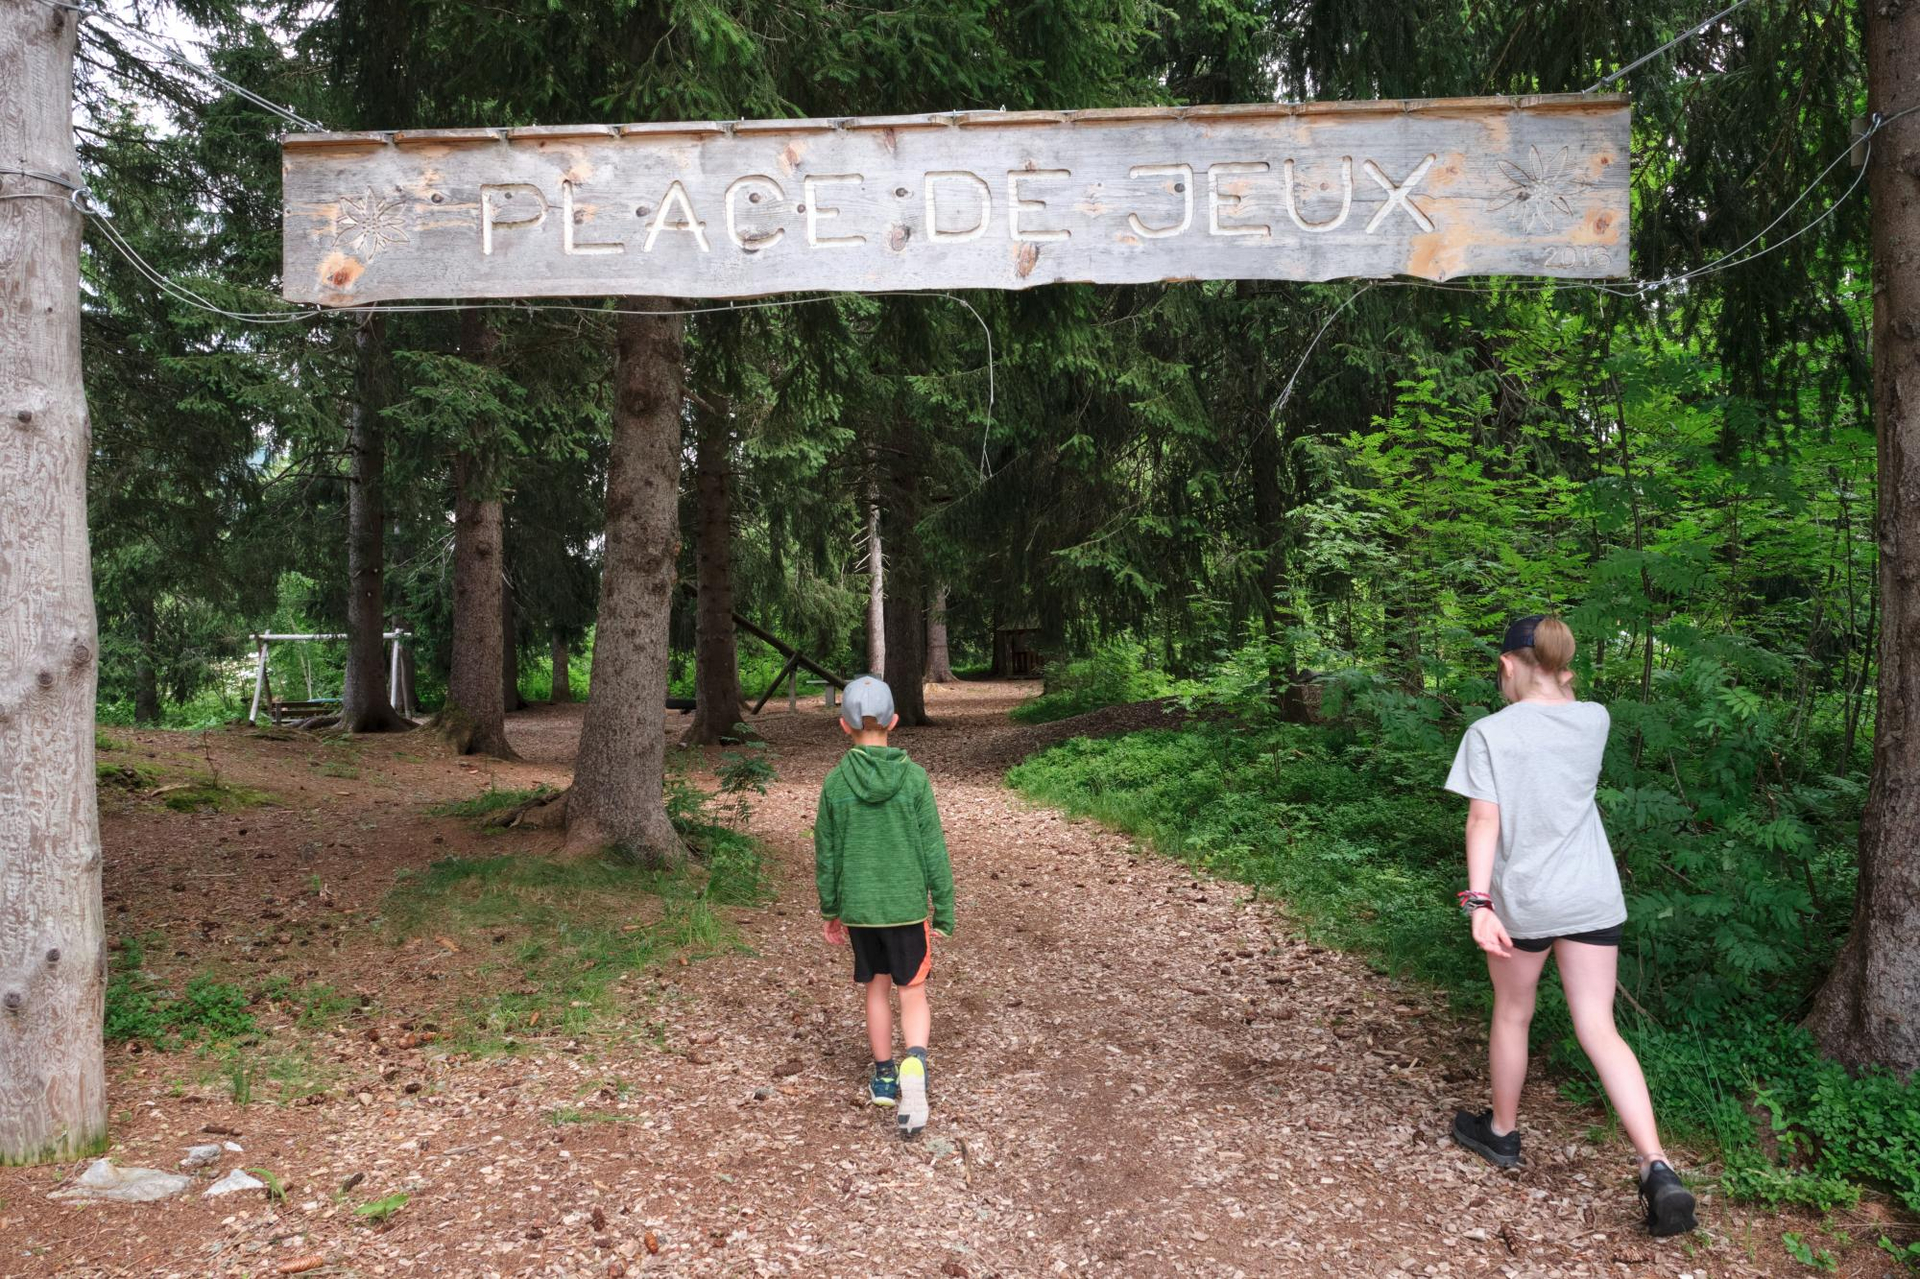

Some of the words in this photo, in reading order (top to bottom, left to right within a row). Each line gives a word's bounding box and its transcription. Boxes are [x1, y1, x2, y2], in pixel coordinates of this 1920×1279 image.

[480, 174, 867, 255] PLACE
[924, 169, 1072, 243] DE
[1129, 155, 1436, 238] JEUX
